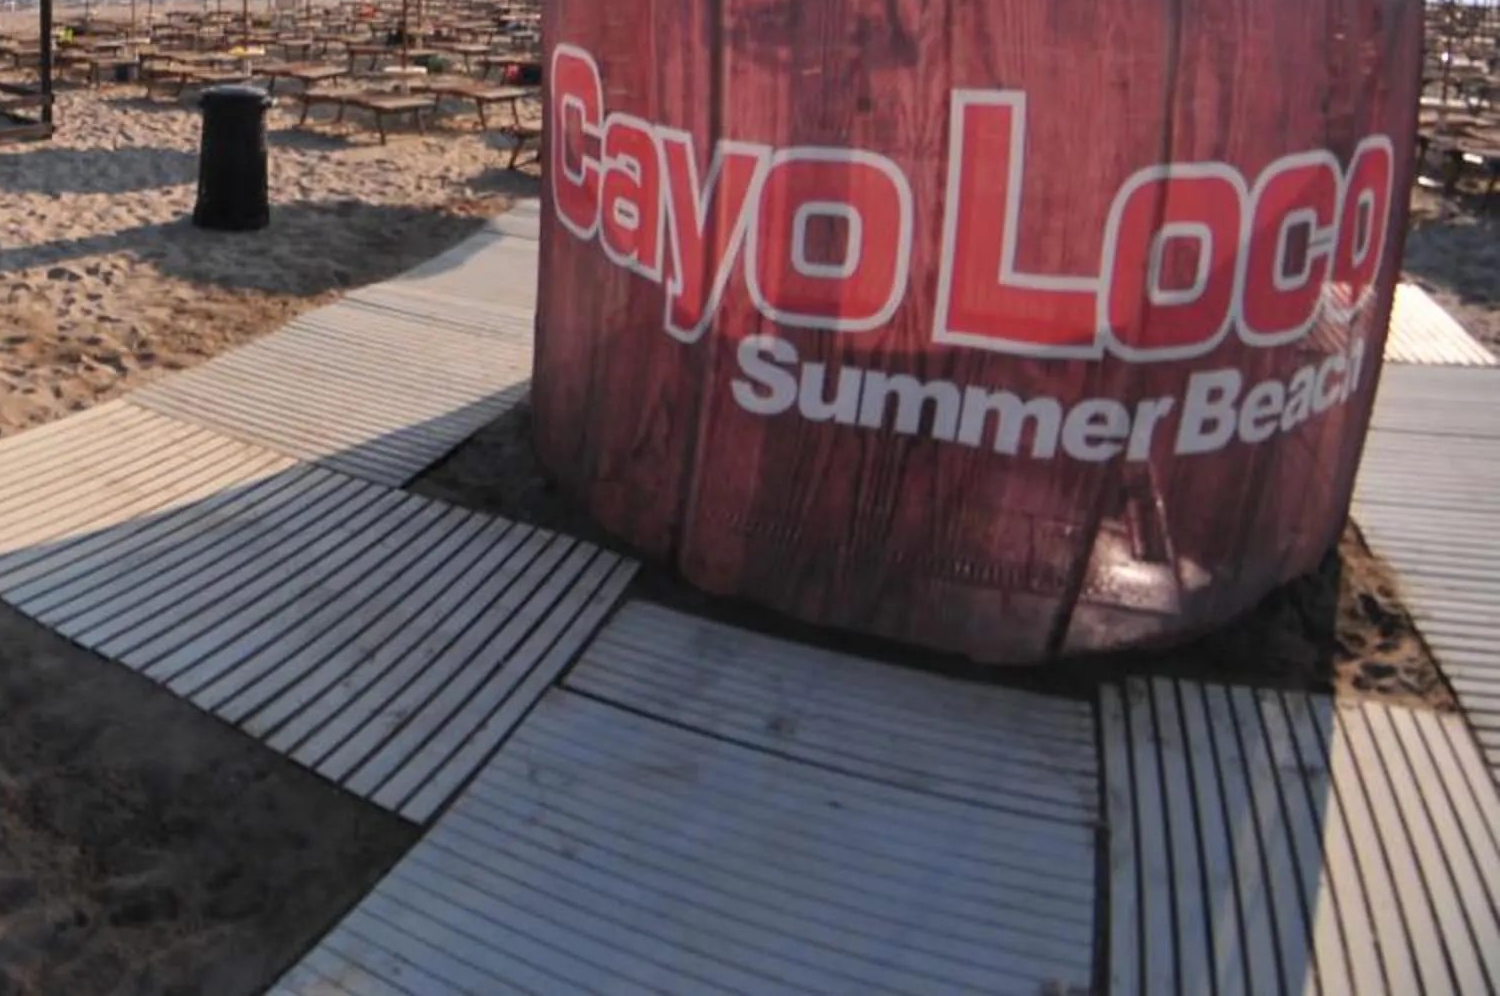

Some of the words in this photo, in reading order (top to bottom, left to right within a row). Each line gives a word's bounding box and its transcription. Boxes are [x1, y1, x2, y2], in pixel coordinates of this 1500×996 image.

[551, 43, 914, 343] Cayo
[933, 89, 1394, 363] Loco
[731, 333, 1175, 462] Summer
[1173, 339, 1365, 455] Beach
